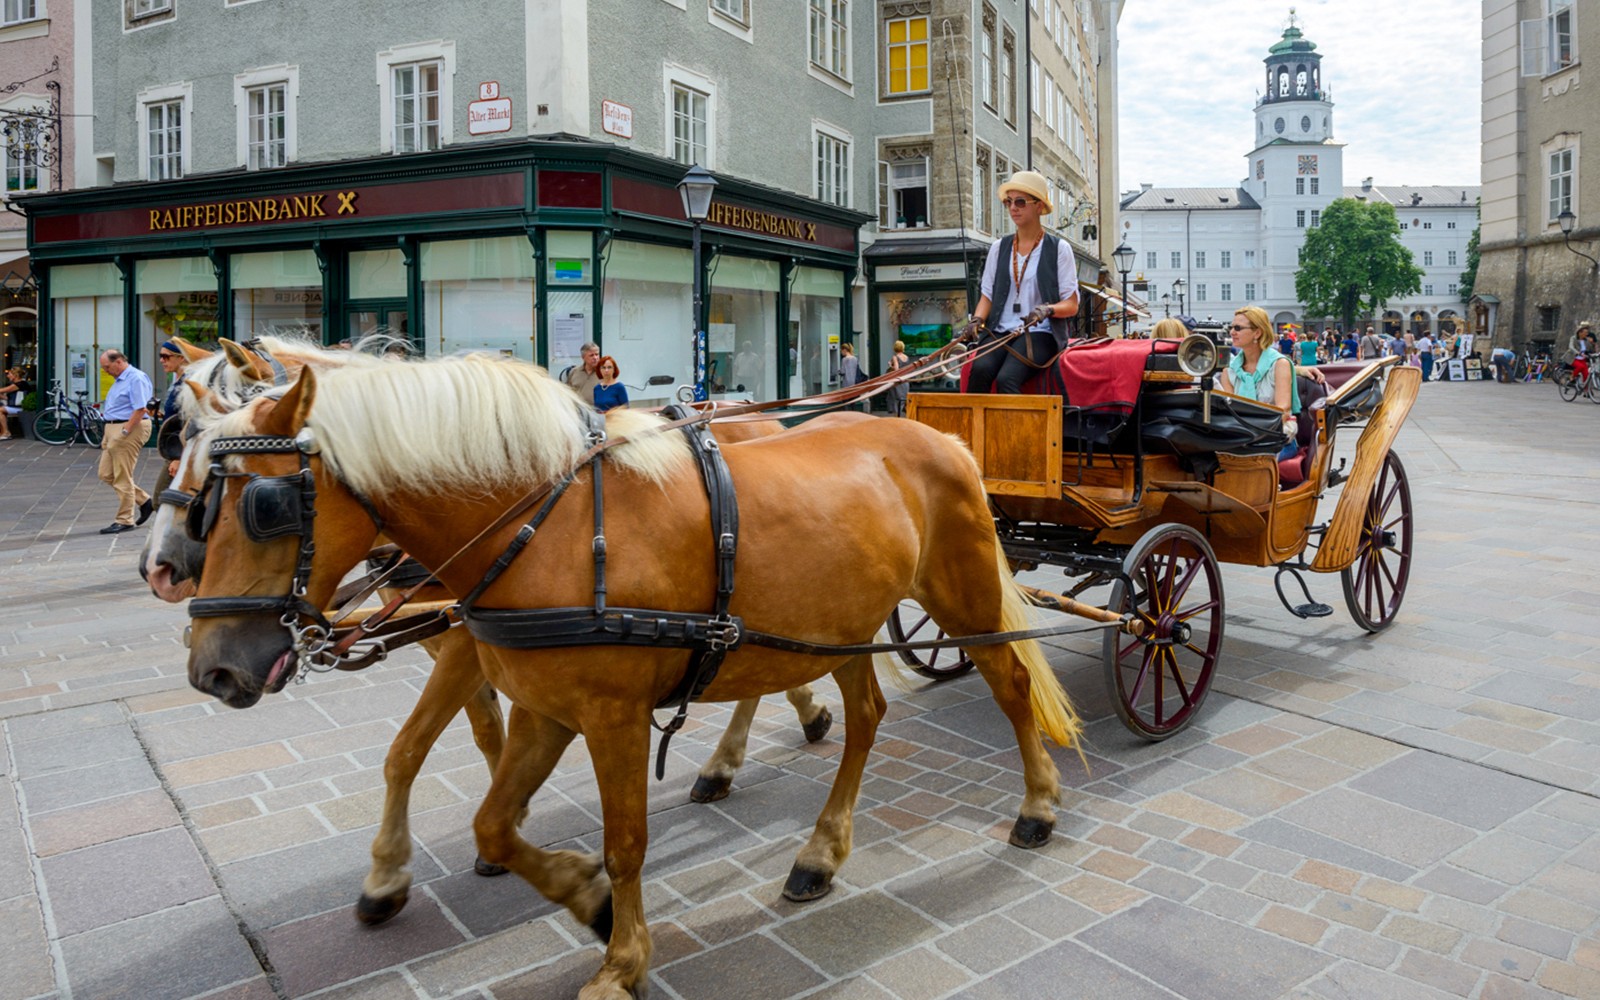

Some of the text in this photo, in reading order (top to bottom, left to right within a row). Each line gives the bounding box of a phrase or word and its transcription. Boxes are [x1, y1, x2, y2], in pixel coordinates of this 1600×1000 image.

[486, 84, 492, 95] 8
[470, 107, 510, 123] Alter Markt
[149, 194, 326, 231] RAIFFEISENBANK
[707, 202, 803, 239] IFFEISENBANK
